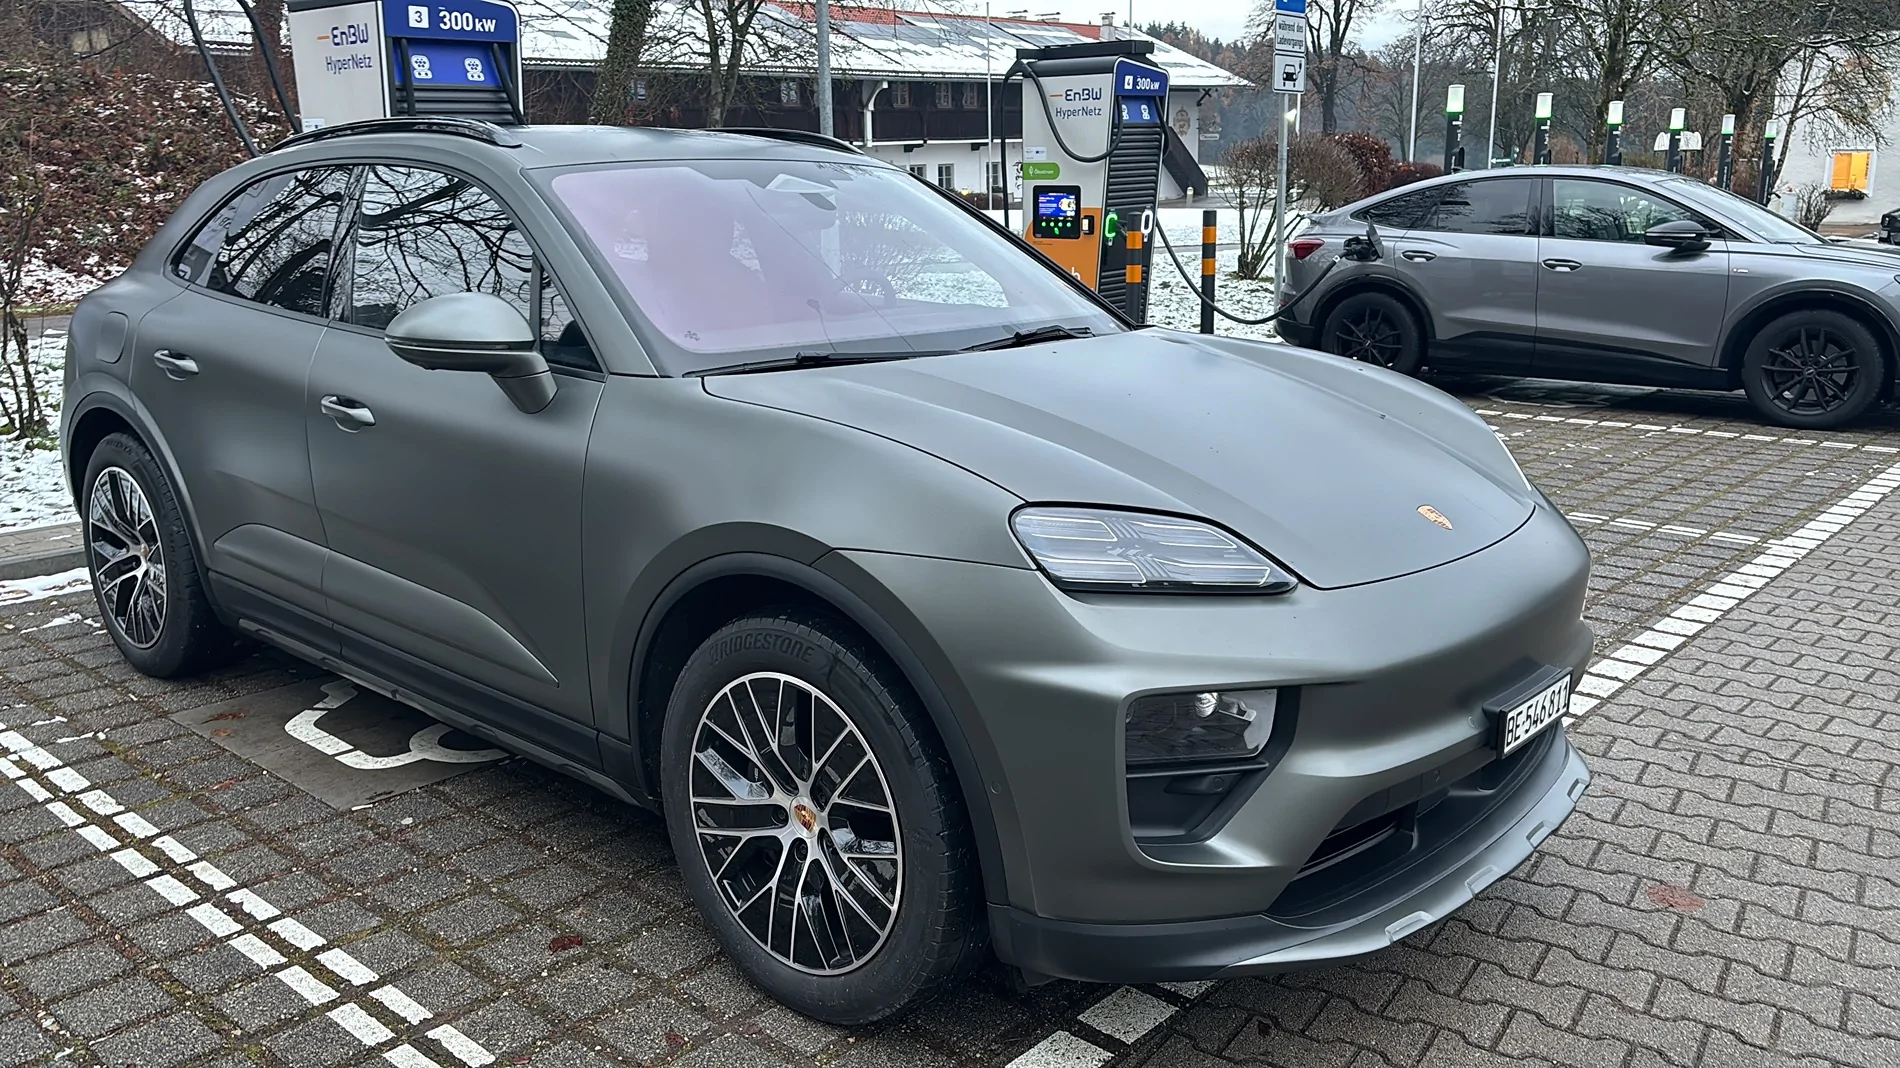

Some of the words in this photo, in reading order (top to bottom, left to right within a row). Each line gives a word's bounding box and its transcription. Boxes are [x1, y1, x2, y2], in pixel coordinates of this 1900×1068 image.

[414, 10, 423, 23] 3
[439, 11, 473, 31] 300
[475, 18, 496, 32] kW
[1278, 20, 1295, 31] während
[331, 23, 369, 46] EnBW
[325, 54, 373, 75] HyperNetz
[1136, 77, 1151, 90] 300
[1065, 87, 1102, 101] EnBW
[1055, 105, 1102, 119] HyperNetz
[709, 632, 815, 664] BRIDGESTONE
